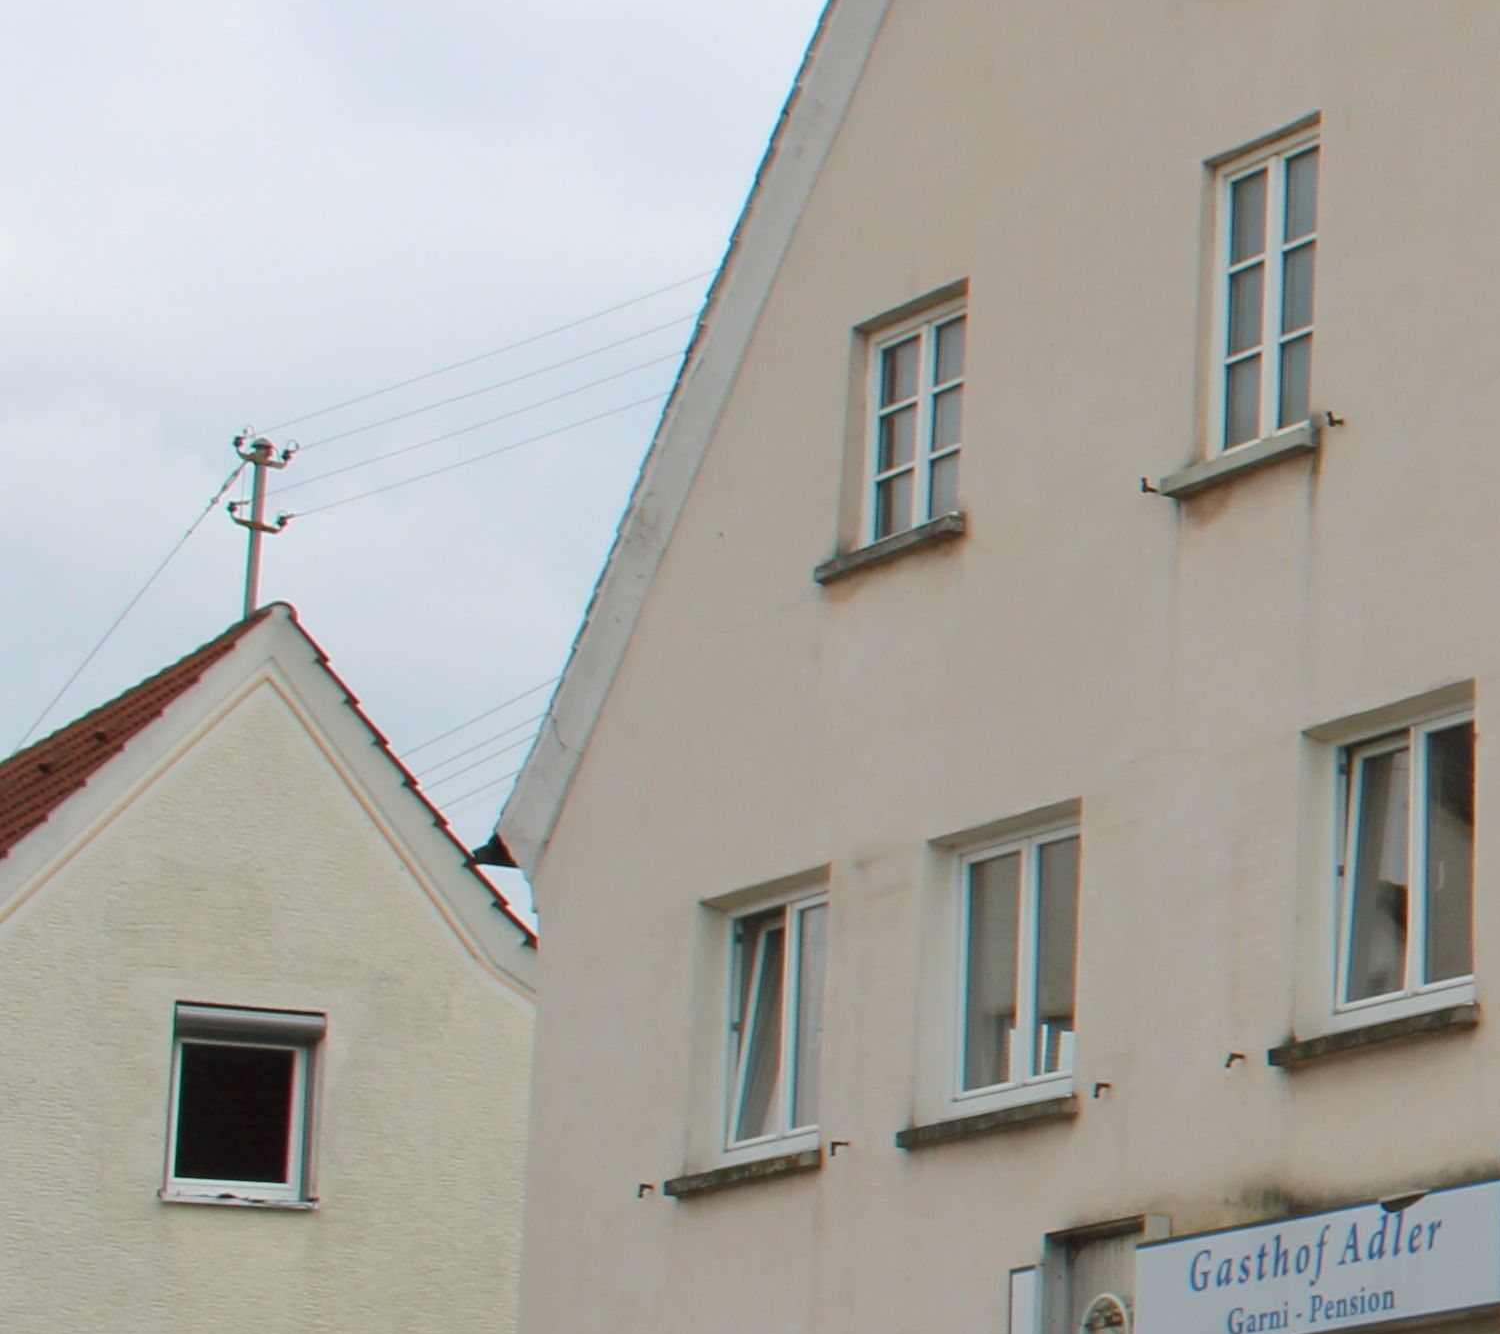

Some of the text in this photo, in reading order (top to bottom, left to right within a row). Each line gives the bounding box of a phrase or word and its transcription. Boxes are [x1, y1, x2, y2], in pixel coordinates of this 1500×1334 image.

[1190, 1208, 1443, 1293] Gasthof Adler
[1308, 1287, 1395, 1324] Pension
